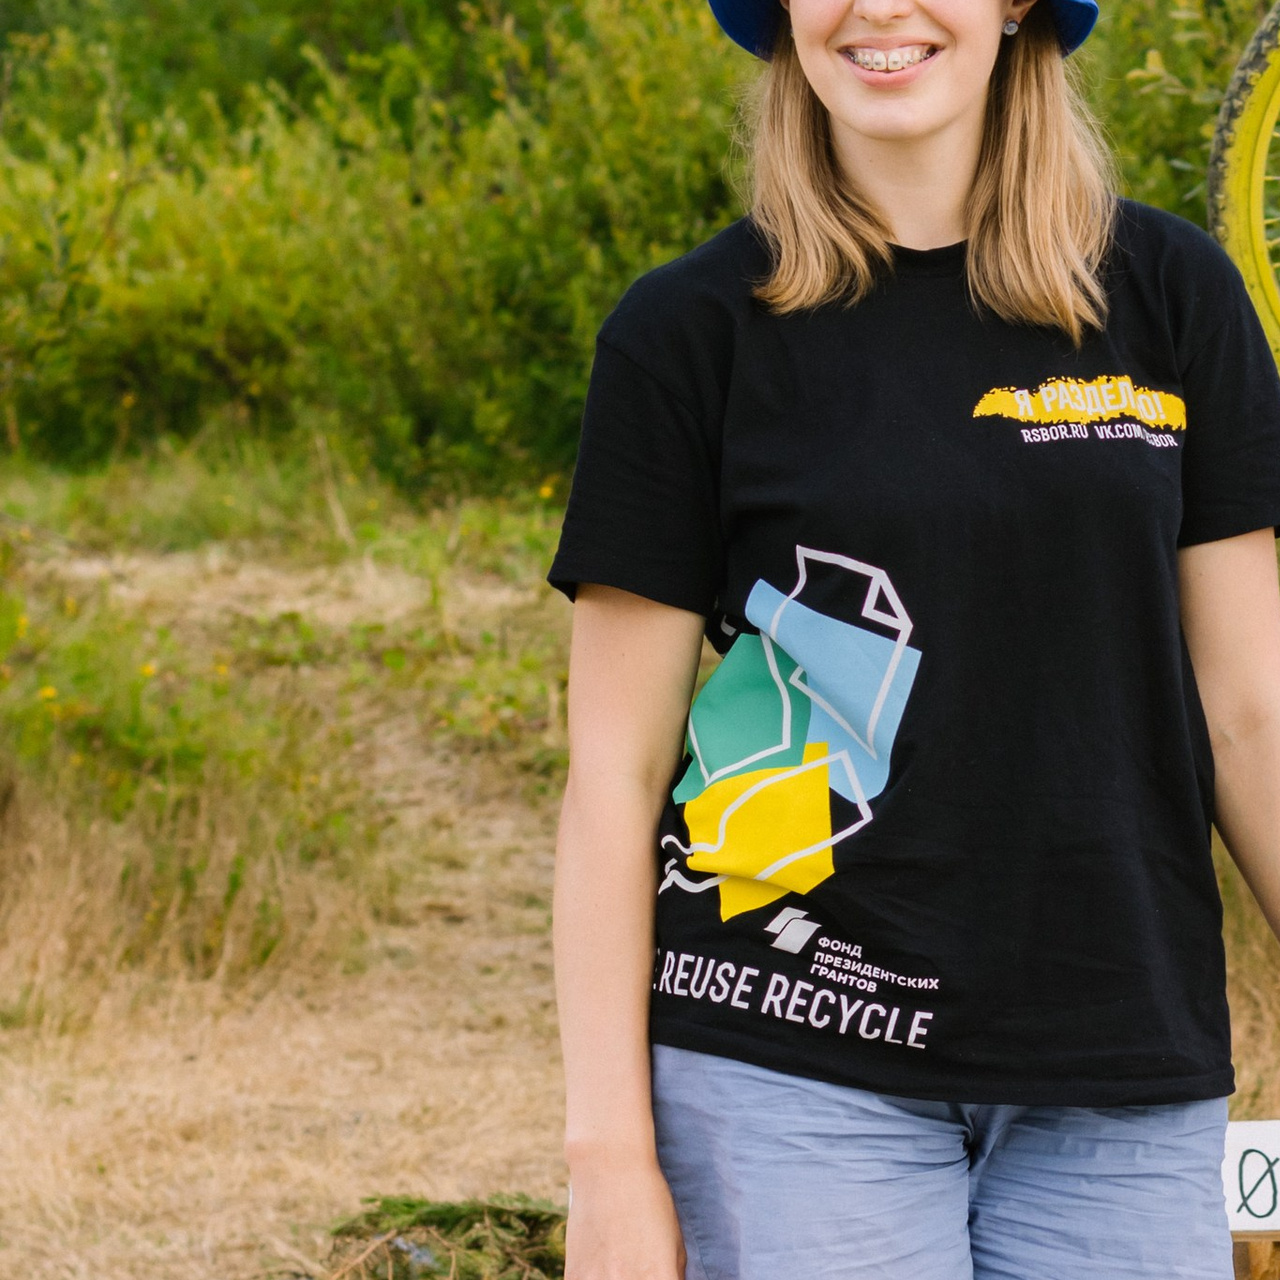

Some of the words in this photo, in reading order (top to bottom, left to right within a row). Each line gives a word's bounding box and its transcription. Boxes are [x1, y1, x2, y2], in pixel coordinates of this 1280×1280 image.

[1014, 389, 1034, 417] Я
[1020, 423, 1089, 443] RSBOR.RU
[818, 935, 862, 959] ФОНД
[810, 964, 878, 993] ГРАНТОВ
[814, 951, 939, 990] ПРЕЗИДЕНТСКИХ
[659, 951, 760, 1010] REUSE
[760, 973, 934, 1049] RECYCLE
